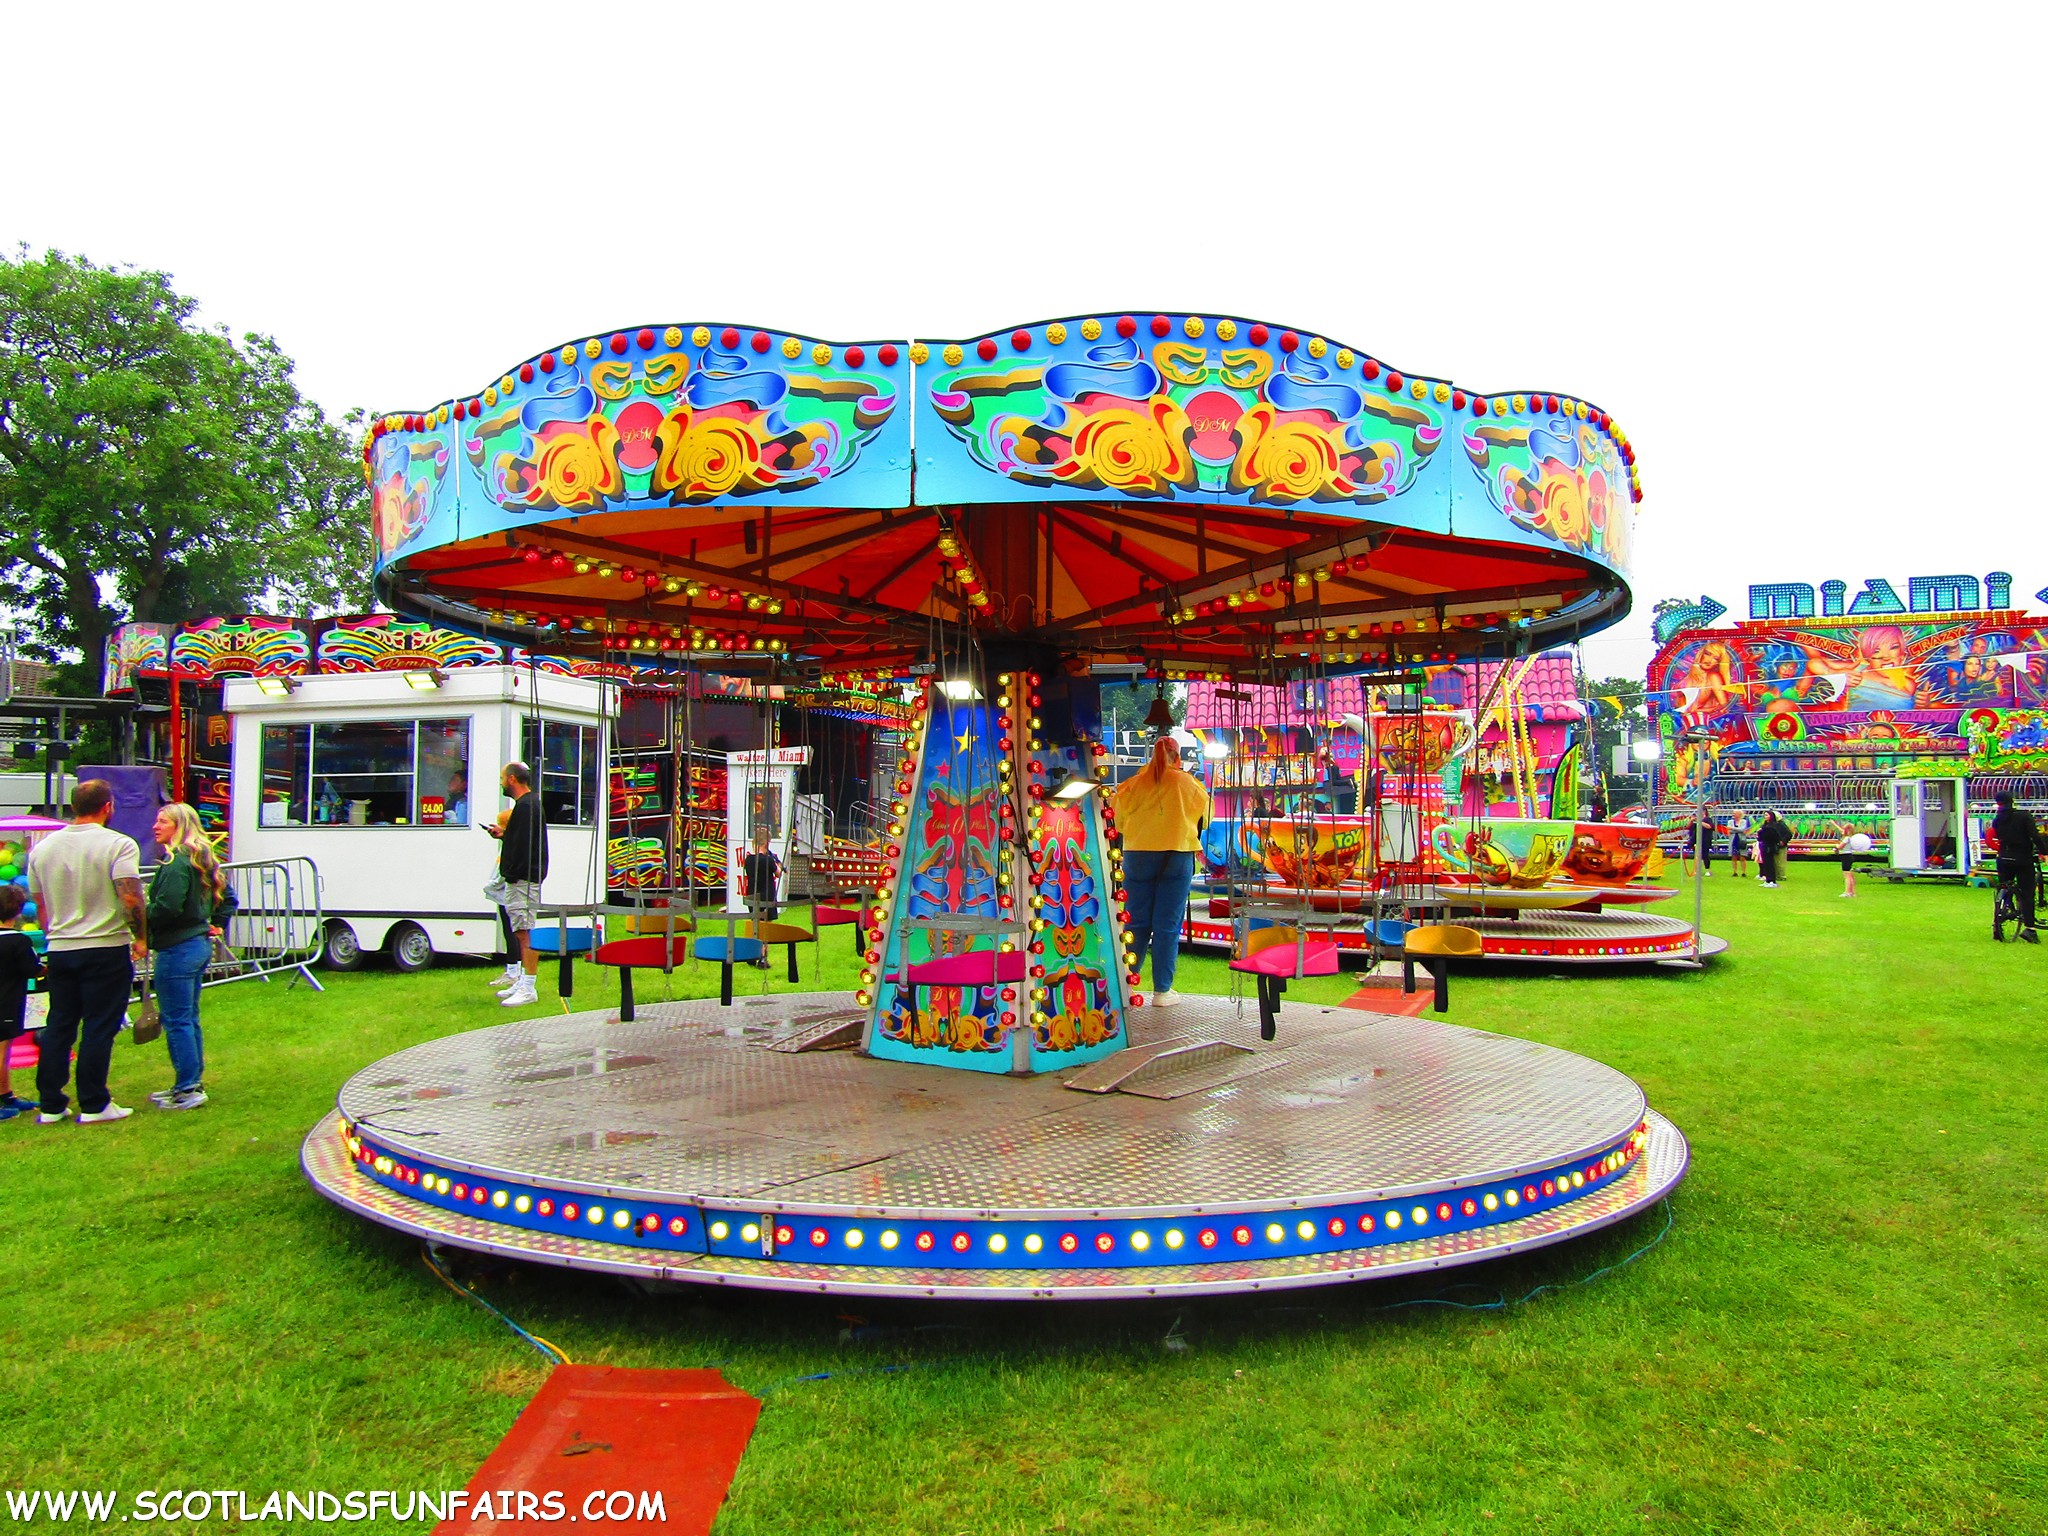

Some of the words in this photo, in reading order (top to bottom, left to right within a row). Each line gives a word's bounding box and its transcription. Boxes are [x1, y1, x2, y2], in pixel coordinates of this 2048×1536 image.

[1794, 632, 1853, 659] DANCE
[1907, 627, 1970, 658] CRAZY
[1757, 740, 1828, 752] SLATERS
[736, 751, 767, 762] Waltze
[778, 750, 806, 762] Miami
[769, 766, 787, 778] Here
[422, 803, 444, 814] £4.00
[1335, 828, 1362, 849] TOY
